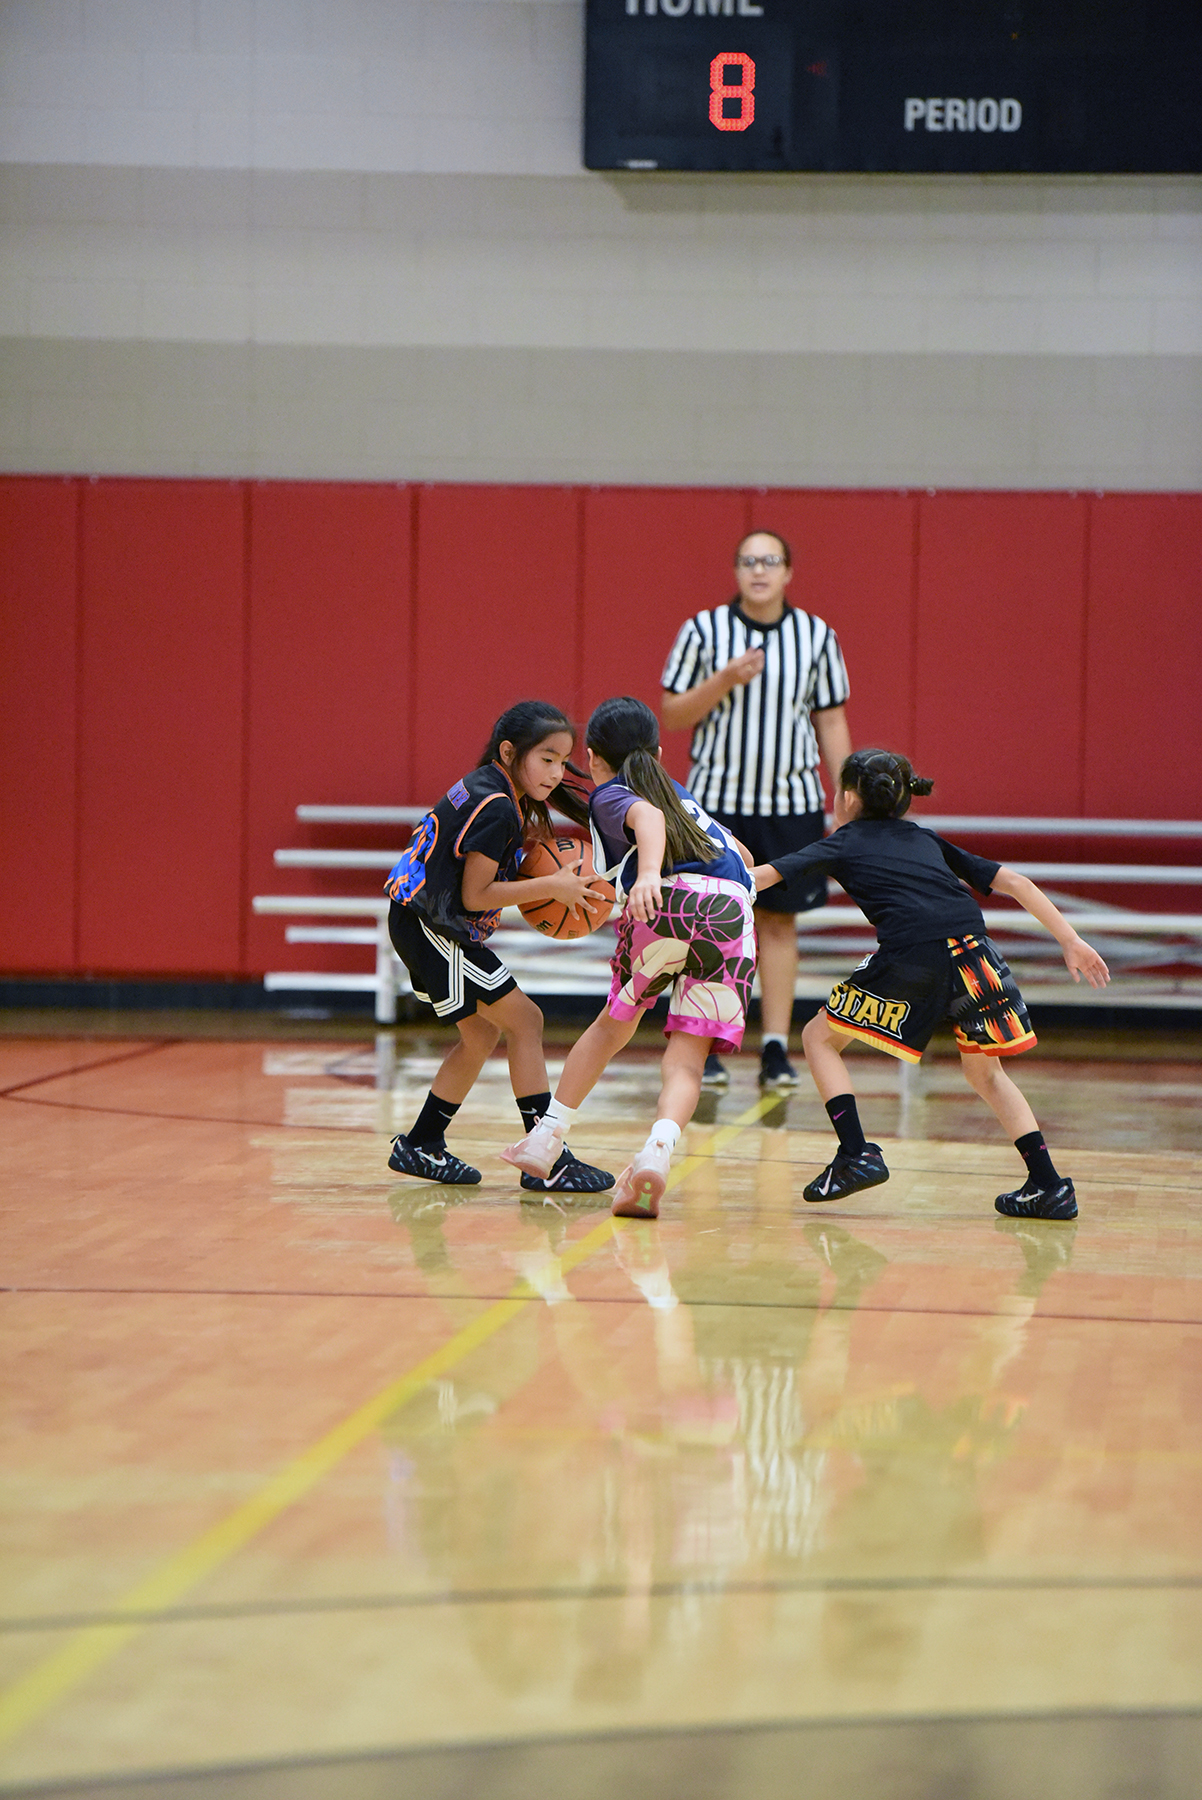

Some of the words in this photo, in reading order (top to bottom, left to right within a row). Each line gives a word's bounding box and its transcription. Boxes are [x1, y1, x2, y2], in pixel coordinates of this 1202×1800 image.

[708, 52, 756, 132] 8
[904, 98, 1022, 132] PERIOD
[827, 983, 908, 1035] STAR
